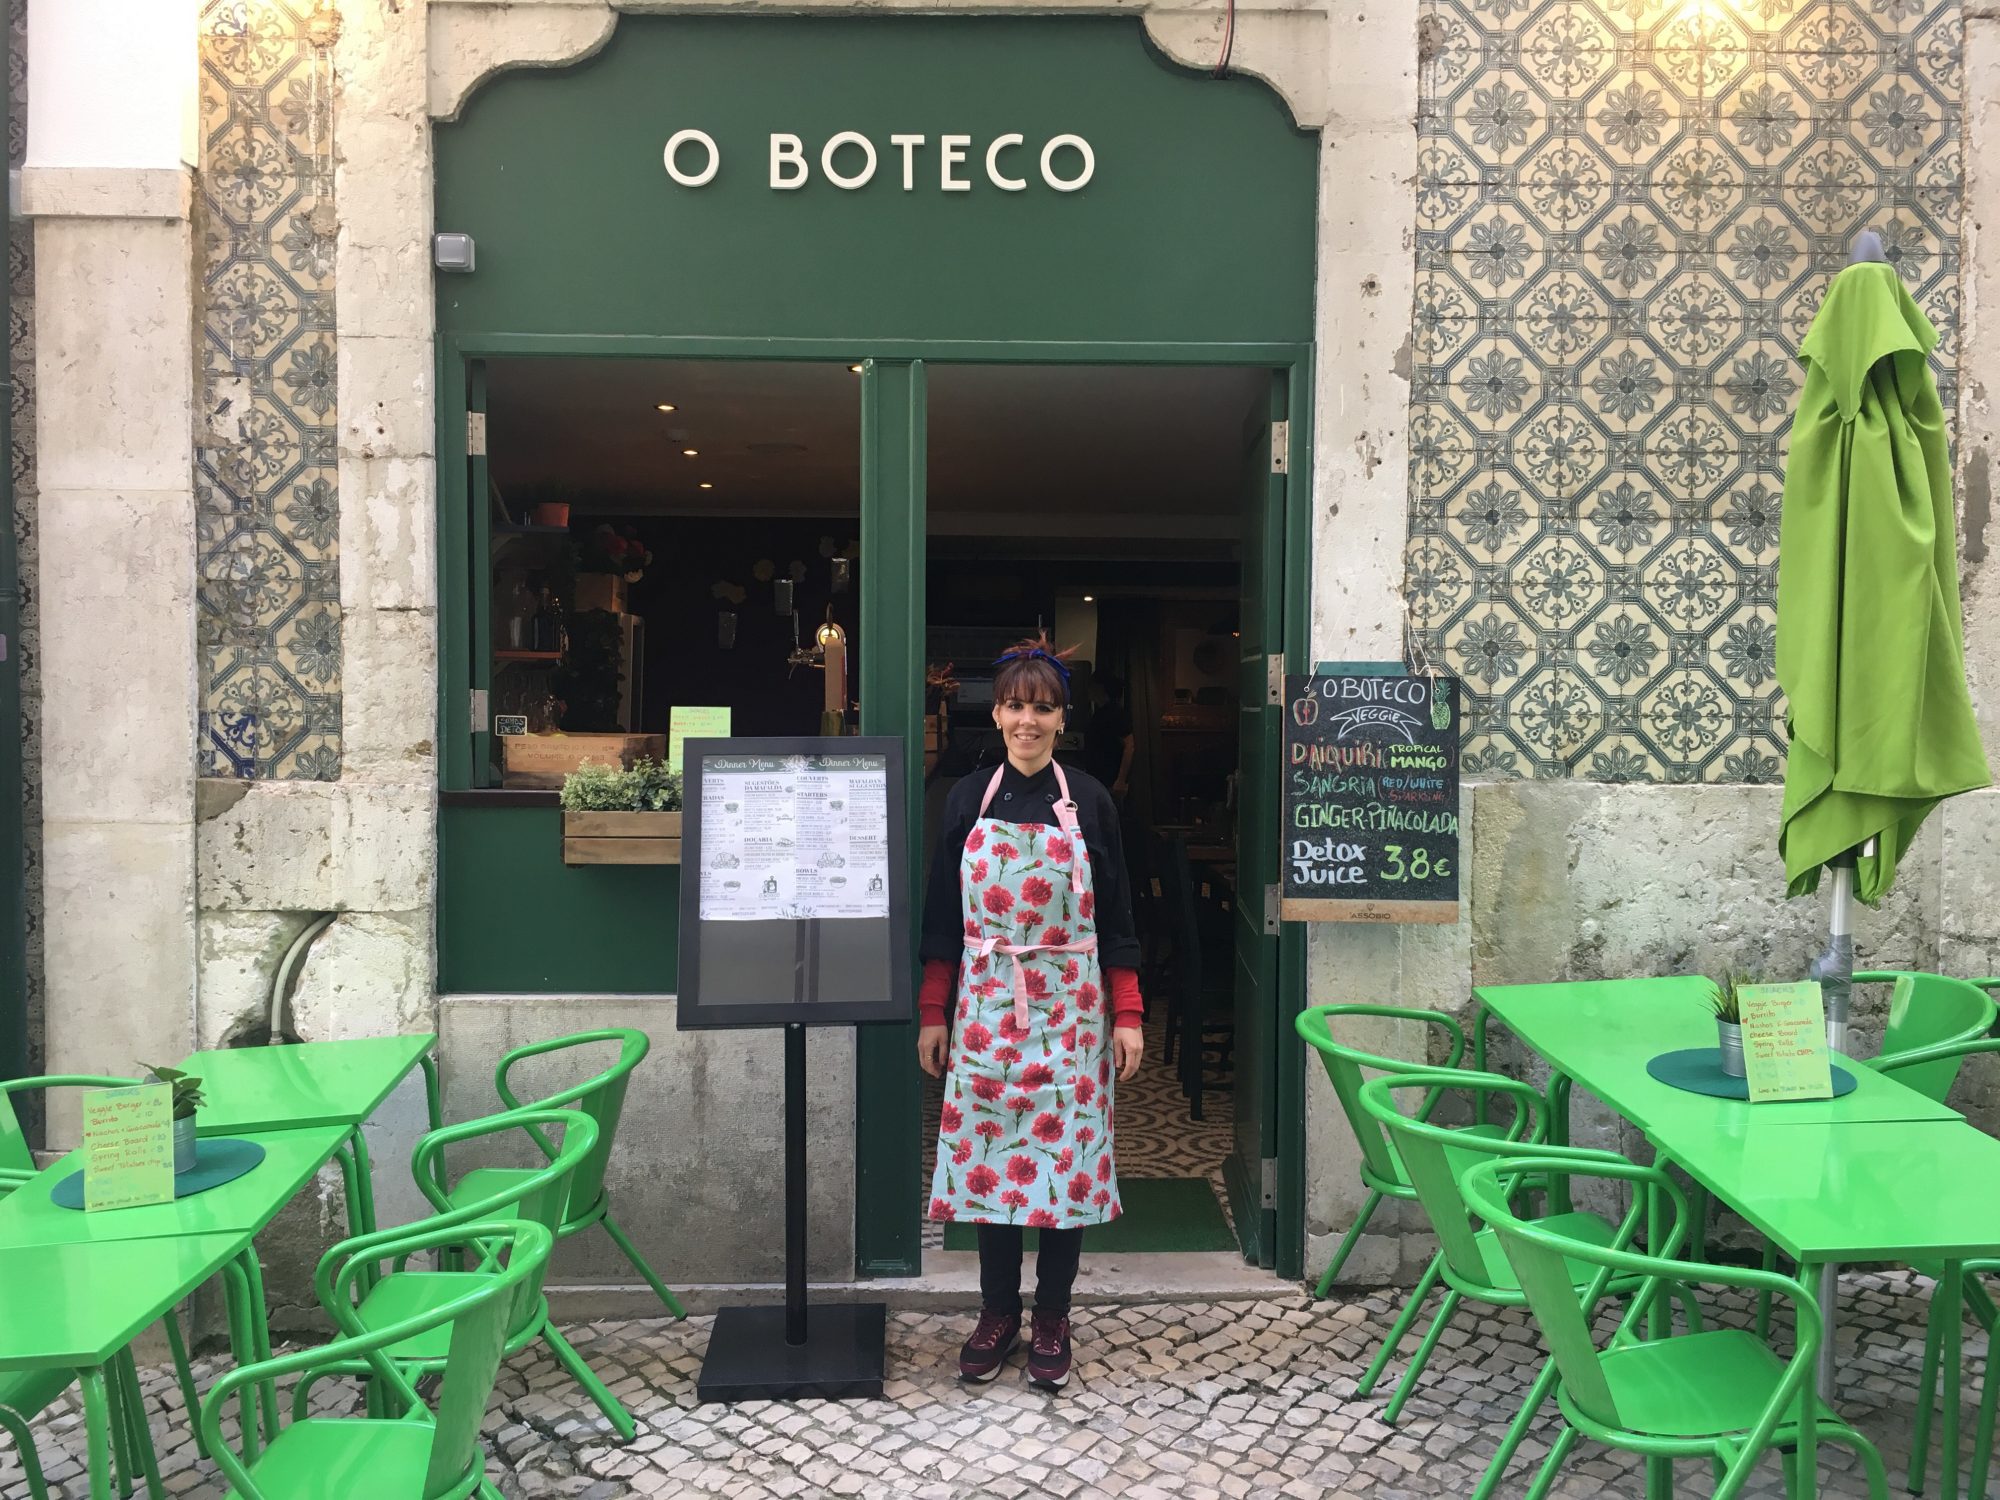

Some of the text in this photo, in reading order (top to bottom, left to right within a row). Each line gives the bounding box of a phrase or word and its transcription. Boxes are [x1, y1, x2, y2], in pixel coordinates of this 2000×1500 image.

[664, 129, 1095, 192] O BOTECO
[1323, 678, 1426, 704] O BOTECO
[714, 758, 774, 771] Dinner Menu
[819, 757, 879, 770] Dinner Menu
[1390, 756, 1448, 771] MANGO
[1292, 837, 1367, 862] Detox
[1293, 860, 1367, 884] Juice
[1751, 1011, 1775, 1019] Burrito
